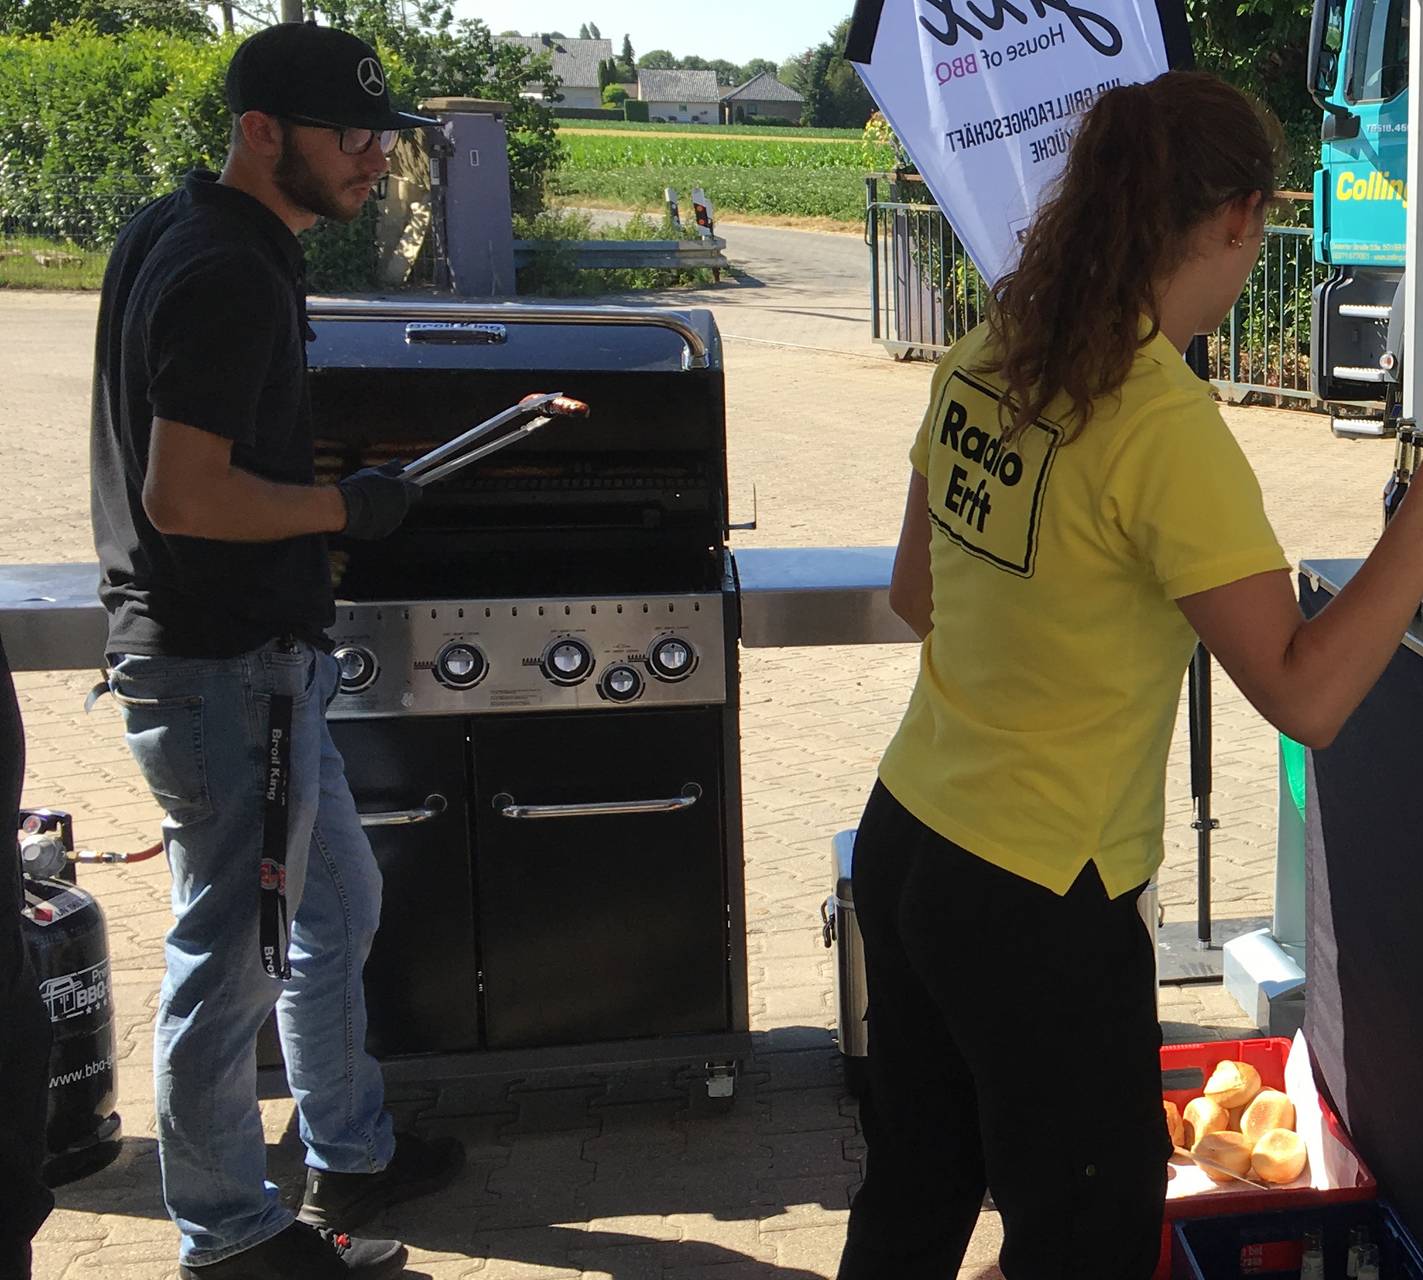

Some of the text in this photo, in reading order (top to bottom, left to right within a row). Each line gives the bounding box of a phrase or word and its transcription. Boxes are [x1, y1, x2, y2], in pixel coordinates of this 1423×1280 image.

[940, 400, 1023, 486] Radio
[944, 464, 992, 533] Erft
[266, 728, 282, 801] Broil King
